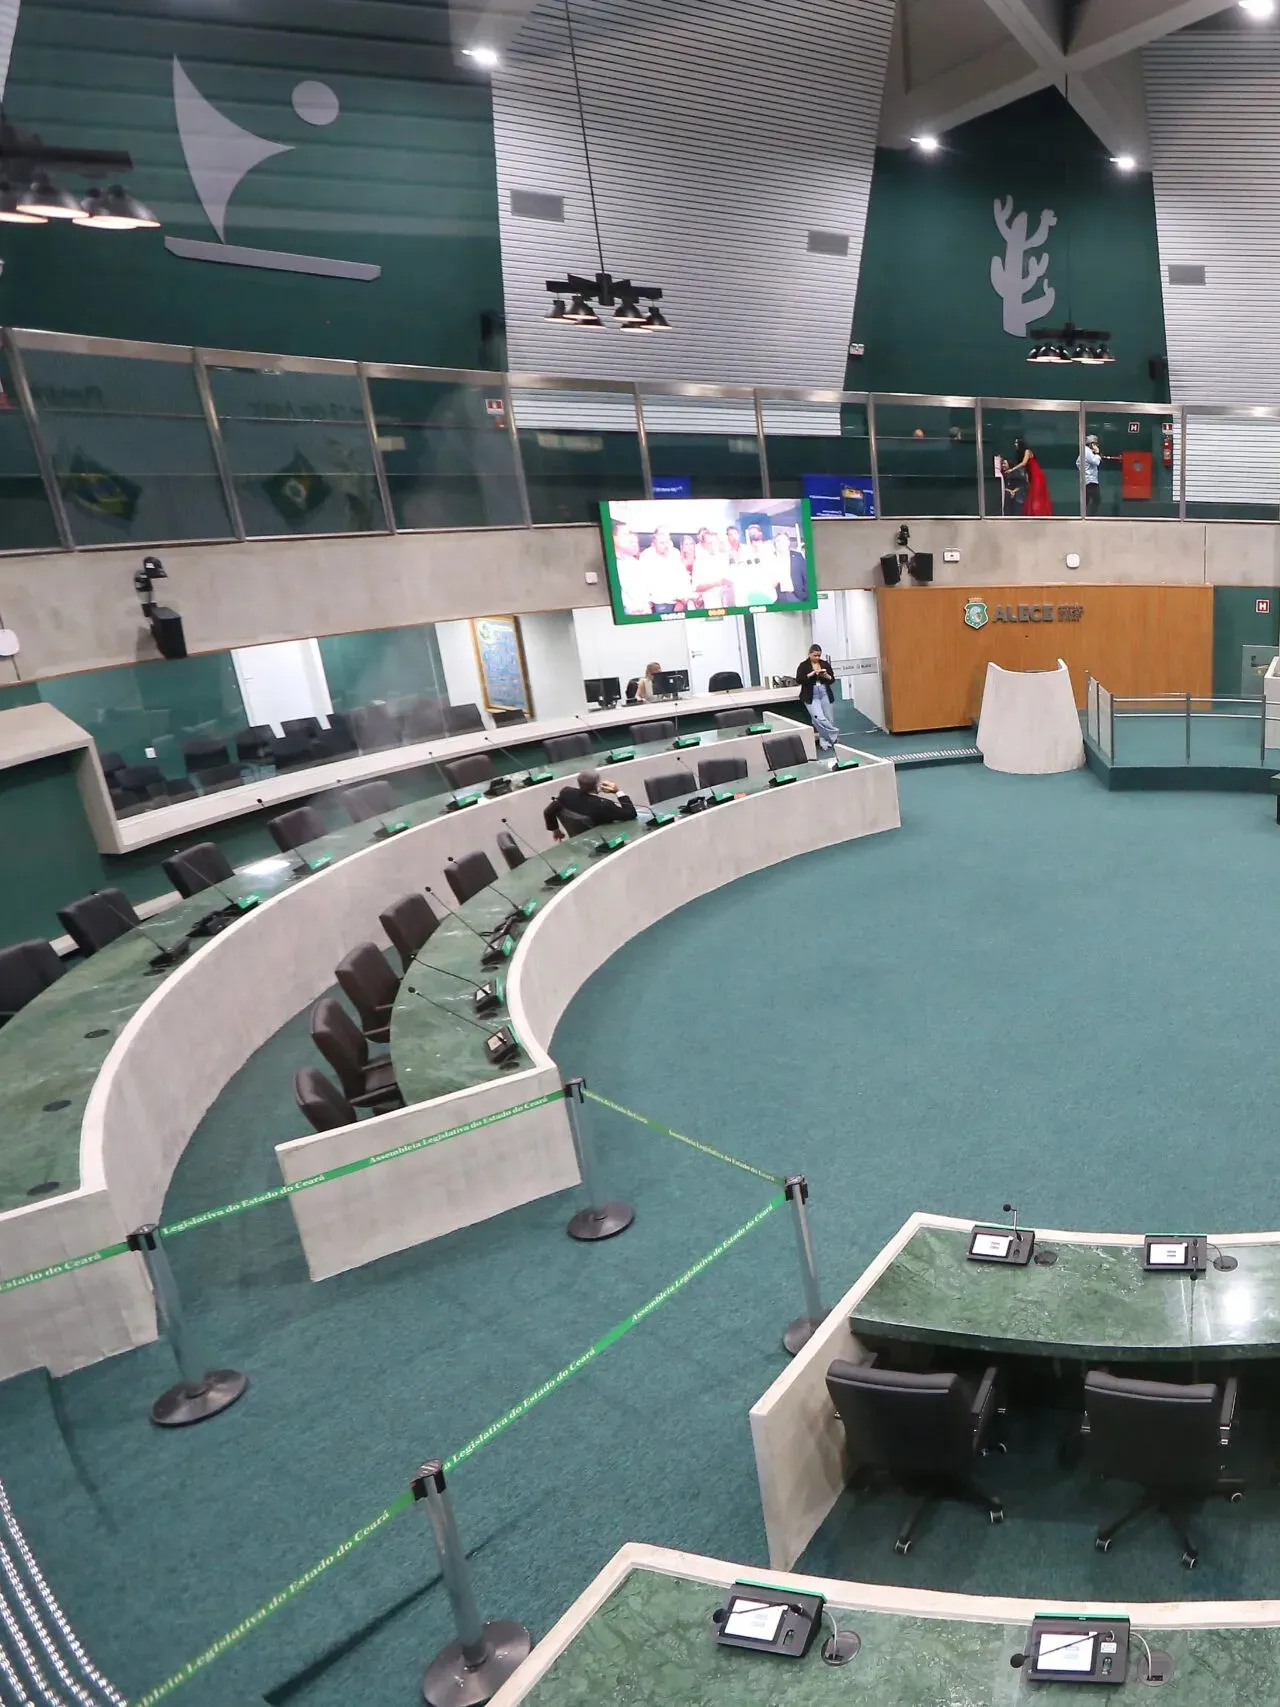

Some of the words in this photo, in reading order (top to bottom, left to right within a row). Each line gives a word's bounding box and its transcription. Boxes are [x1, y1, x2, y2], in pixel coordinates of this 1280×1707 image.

[993, 604, 1055, 623] ALECE
[422, 1125, 471, 1145] Legislativa
[483, 1110, 512, 1124] Estado
[163, 1210, 224, 1235] Legislativa
[225, 1203, 240, 1213] do
[242, 1191, 279, 1208] Estado
[280, 1185, 294, 1195] do
[295, 1174, 326, 1189] Ceará
[722, 1227, 746, 1249] Estado
[45, 1264, 63, 1276] do
[64, 1252, 102, 1270] Ceará
[452, 1416, 508, 1463] Legislativa
[509, 1405, 522, 1419] do
[523, 1380, 556, 1408] Estado
[556, 1369, 569, 1382] do
[569, 1346, 596, 1371] Ceará
[186, 1607, 267, 1673] Legislativa
[268, 1592, 288, 1610] do
[288, 1553, 335, 1594] Estado
[335, 1541, 353, 1557] do
[354, 1509, 391, 1542] Ceará
